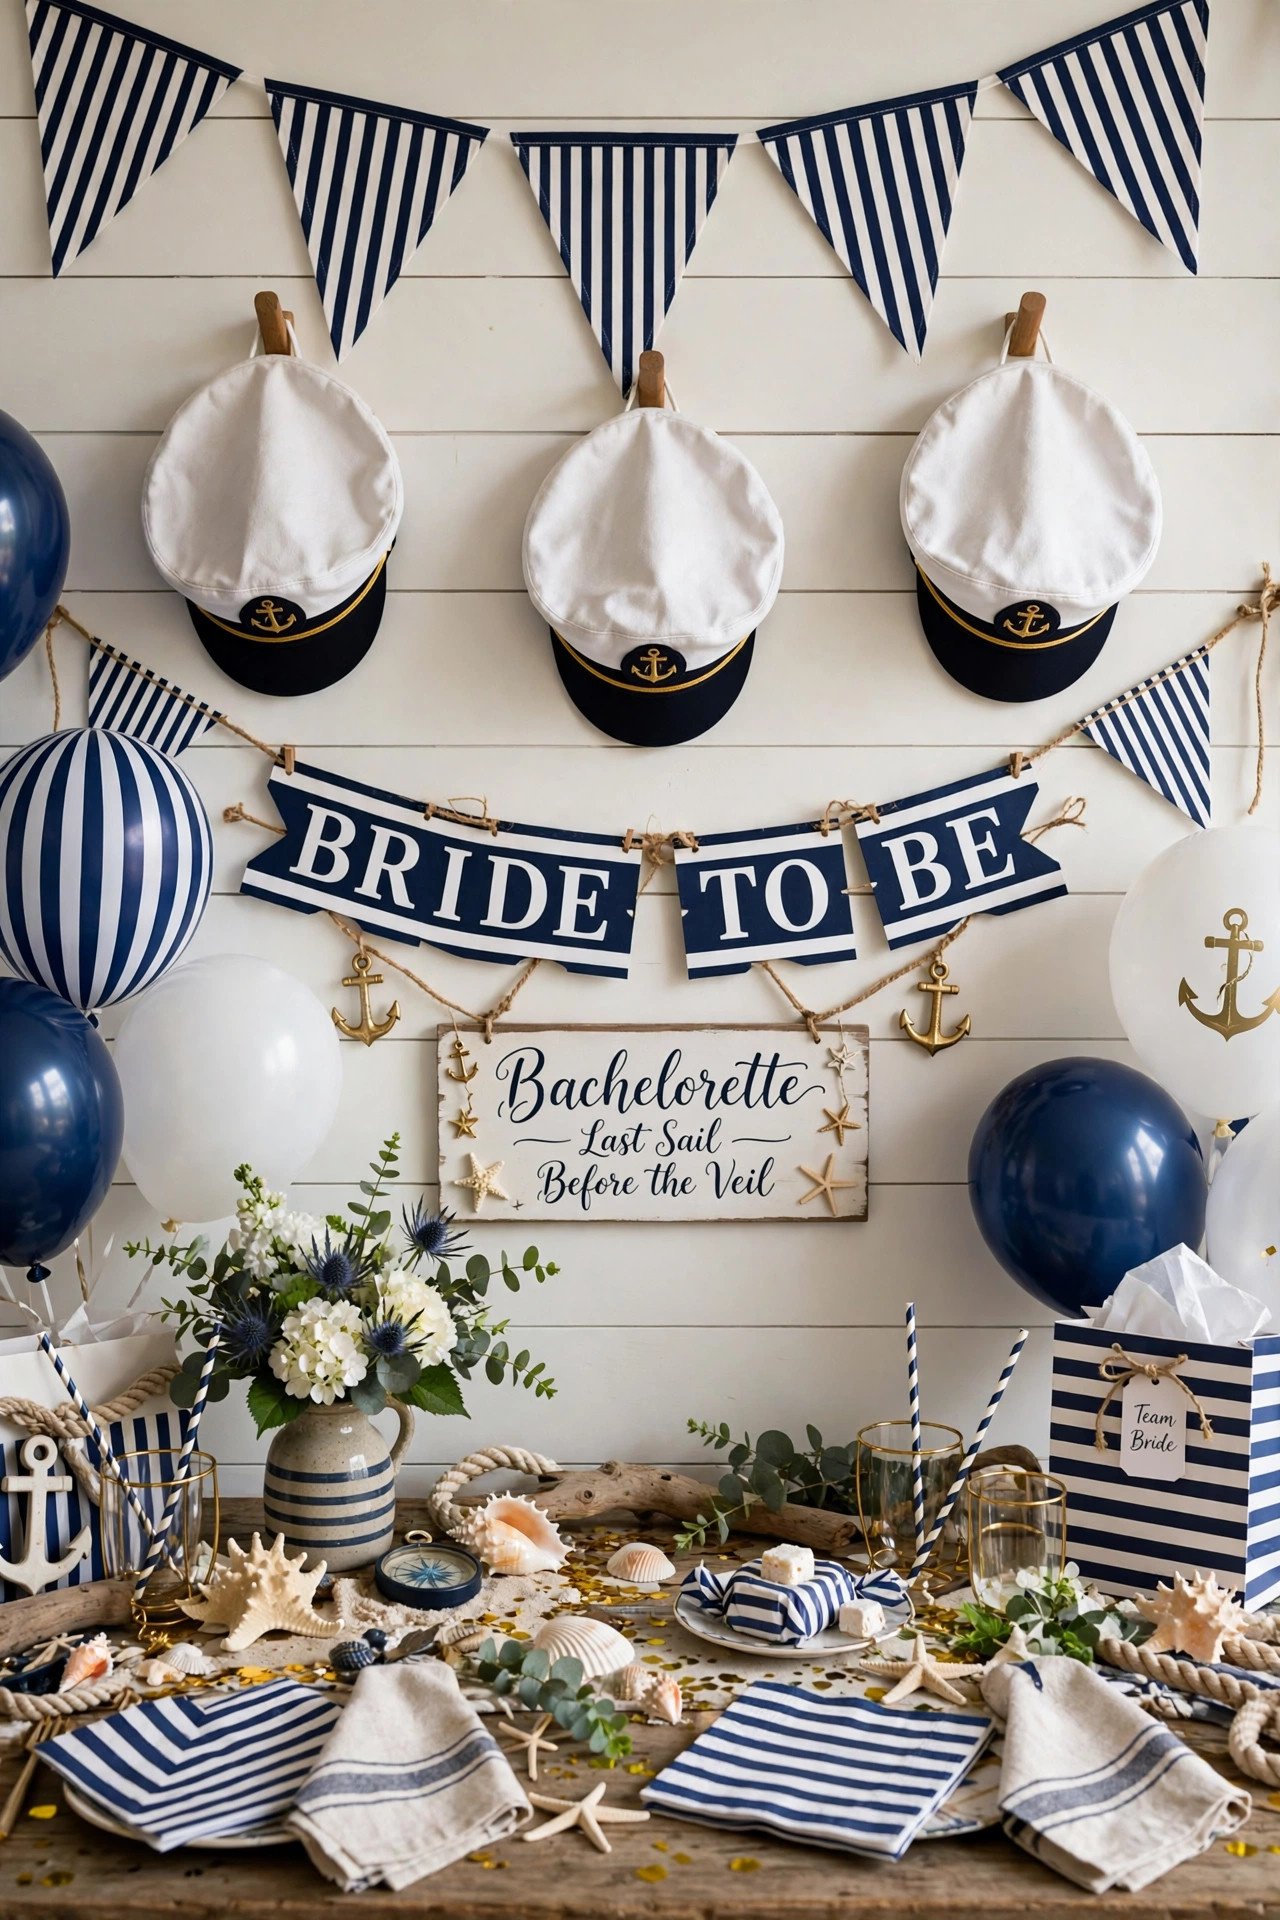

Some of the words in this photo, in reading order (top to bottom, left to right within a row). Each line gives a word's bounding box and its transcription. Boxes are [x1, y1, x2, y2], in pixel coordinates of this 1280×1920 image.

[289, 803, 610, 941] BRIDE
[699, 859, 829, 941] TO
[881, 807, 1016, 910] BE
[495, 1046, 826, 1123] Bachelorette
[578, 1118, 653, 1158] Last
[655, 1117, 722, 1157] Sail
[537, 1159, 639, 1211] Before
[644, 1161, 697, 1197] the
[705, 1156, 775, 1199] Veil
[1134, 1403, 1176, 1427] Team
[1130, 1429, 1178, 1452] Bride
